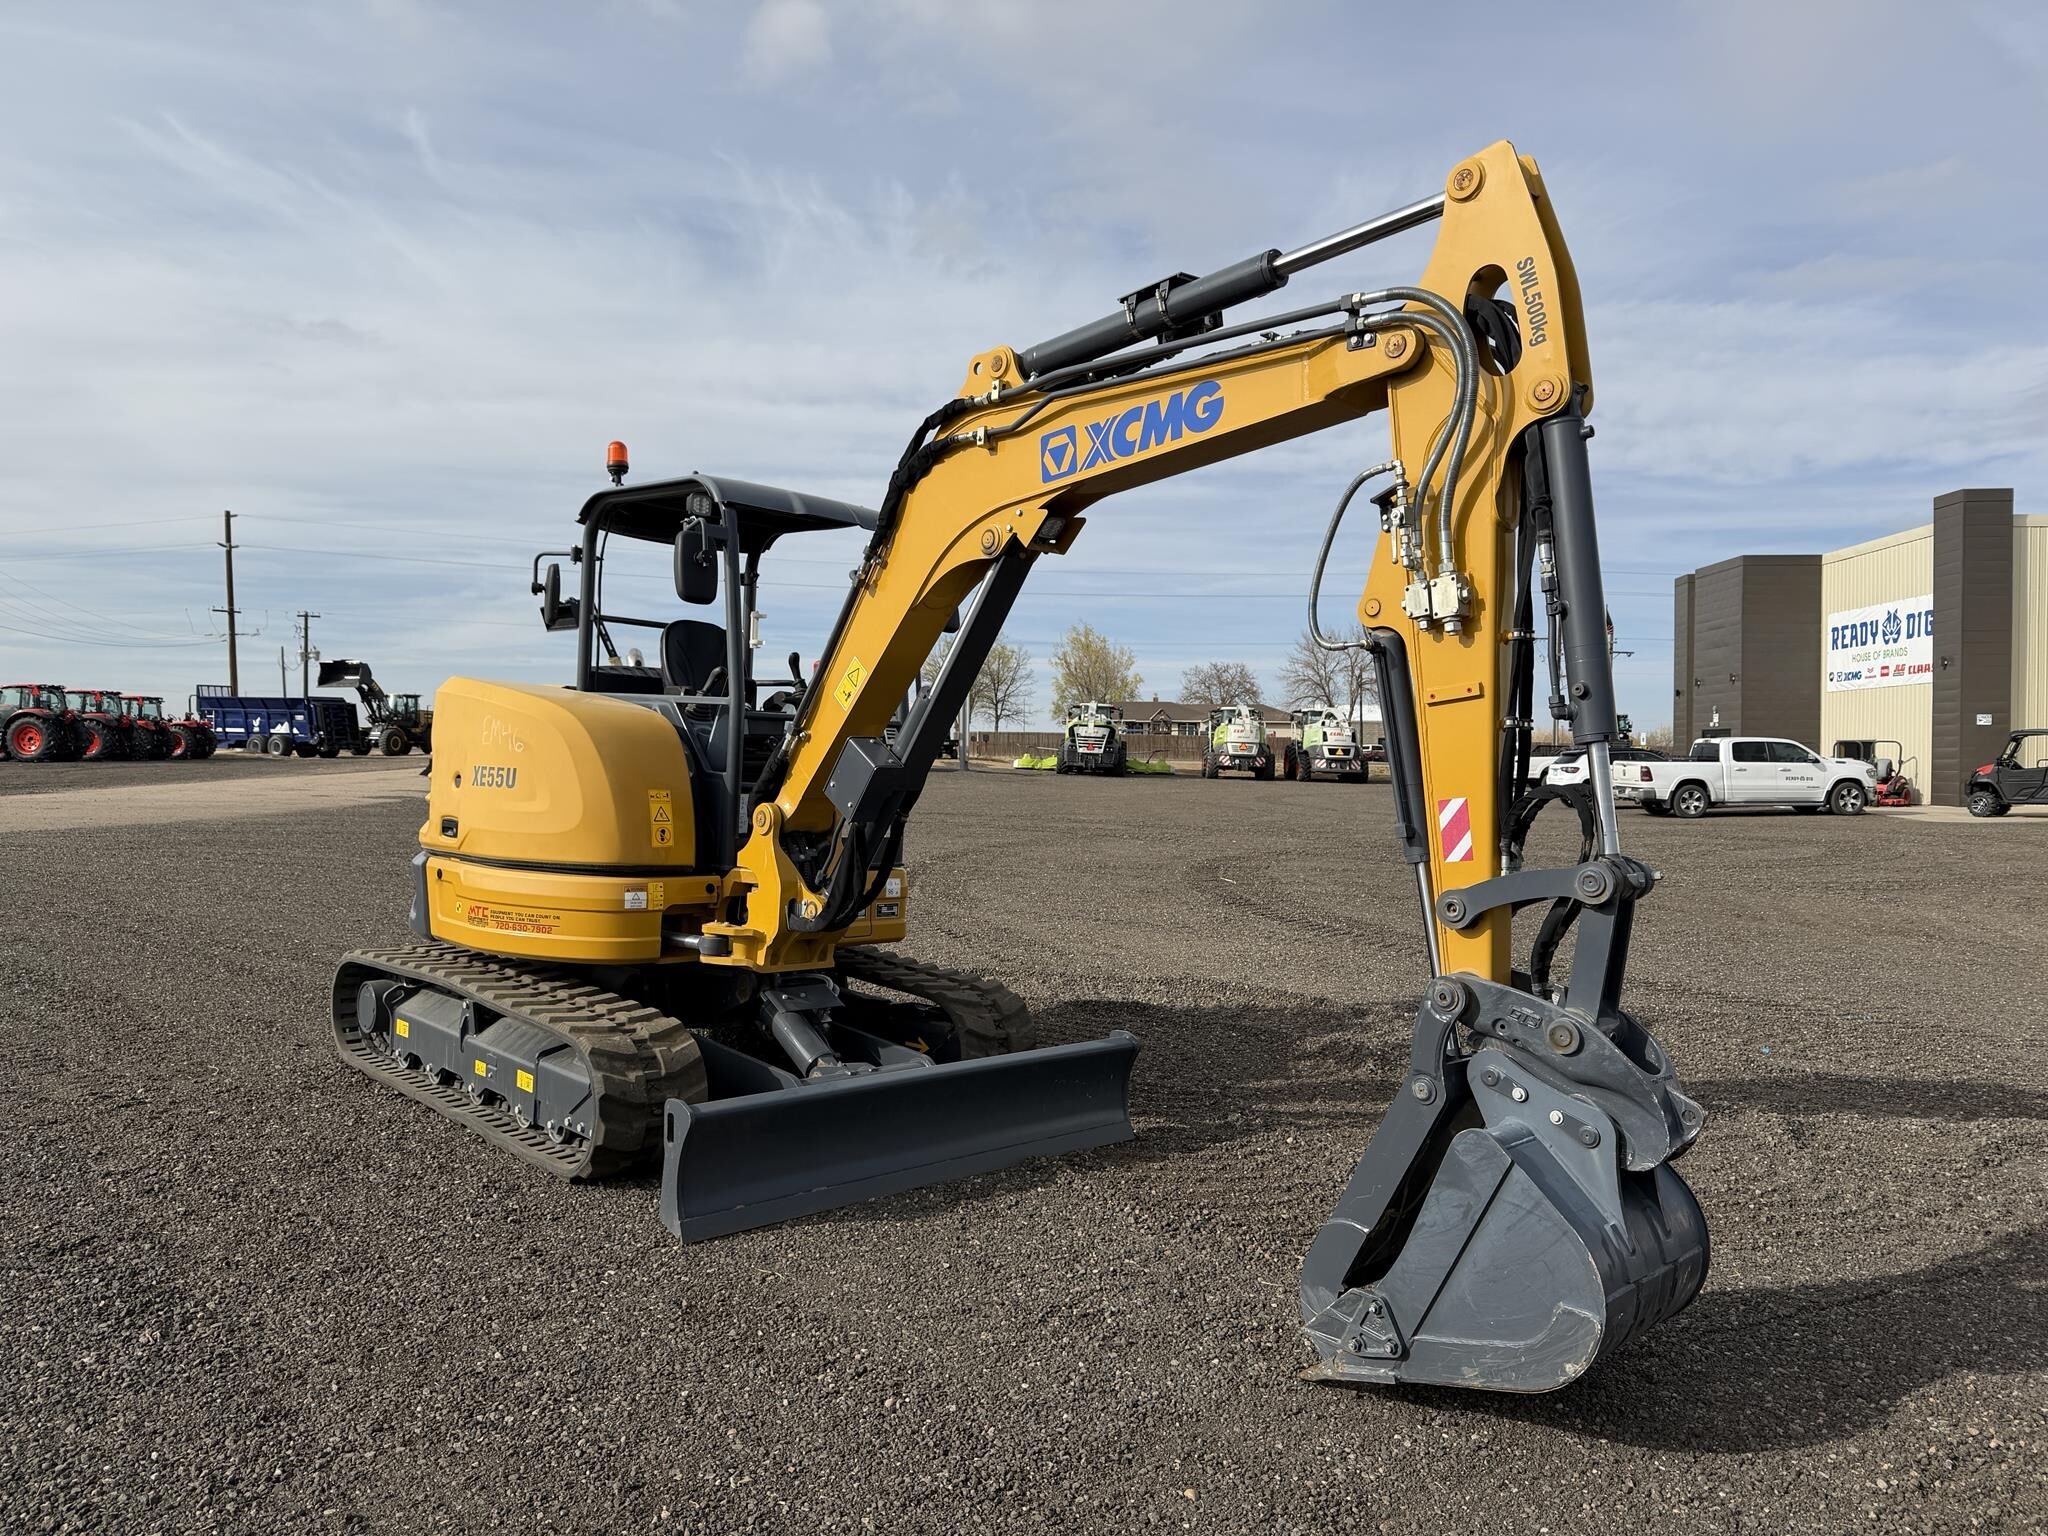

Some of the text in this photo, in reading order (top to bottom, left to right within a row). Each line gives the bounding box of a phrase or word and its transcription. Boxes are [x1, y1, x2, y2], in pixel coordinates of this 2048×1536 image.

[1516, 256, 1548, 347] SWL500kg
[1078, 380, 1225, 473] XCMG
[1831, 609, 1933, 651] READY DIG
[1852, 647, 1908, 663] HOUSE OF BRANDS
[472, 765, 517, 788] XE55U
